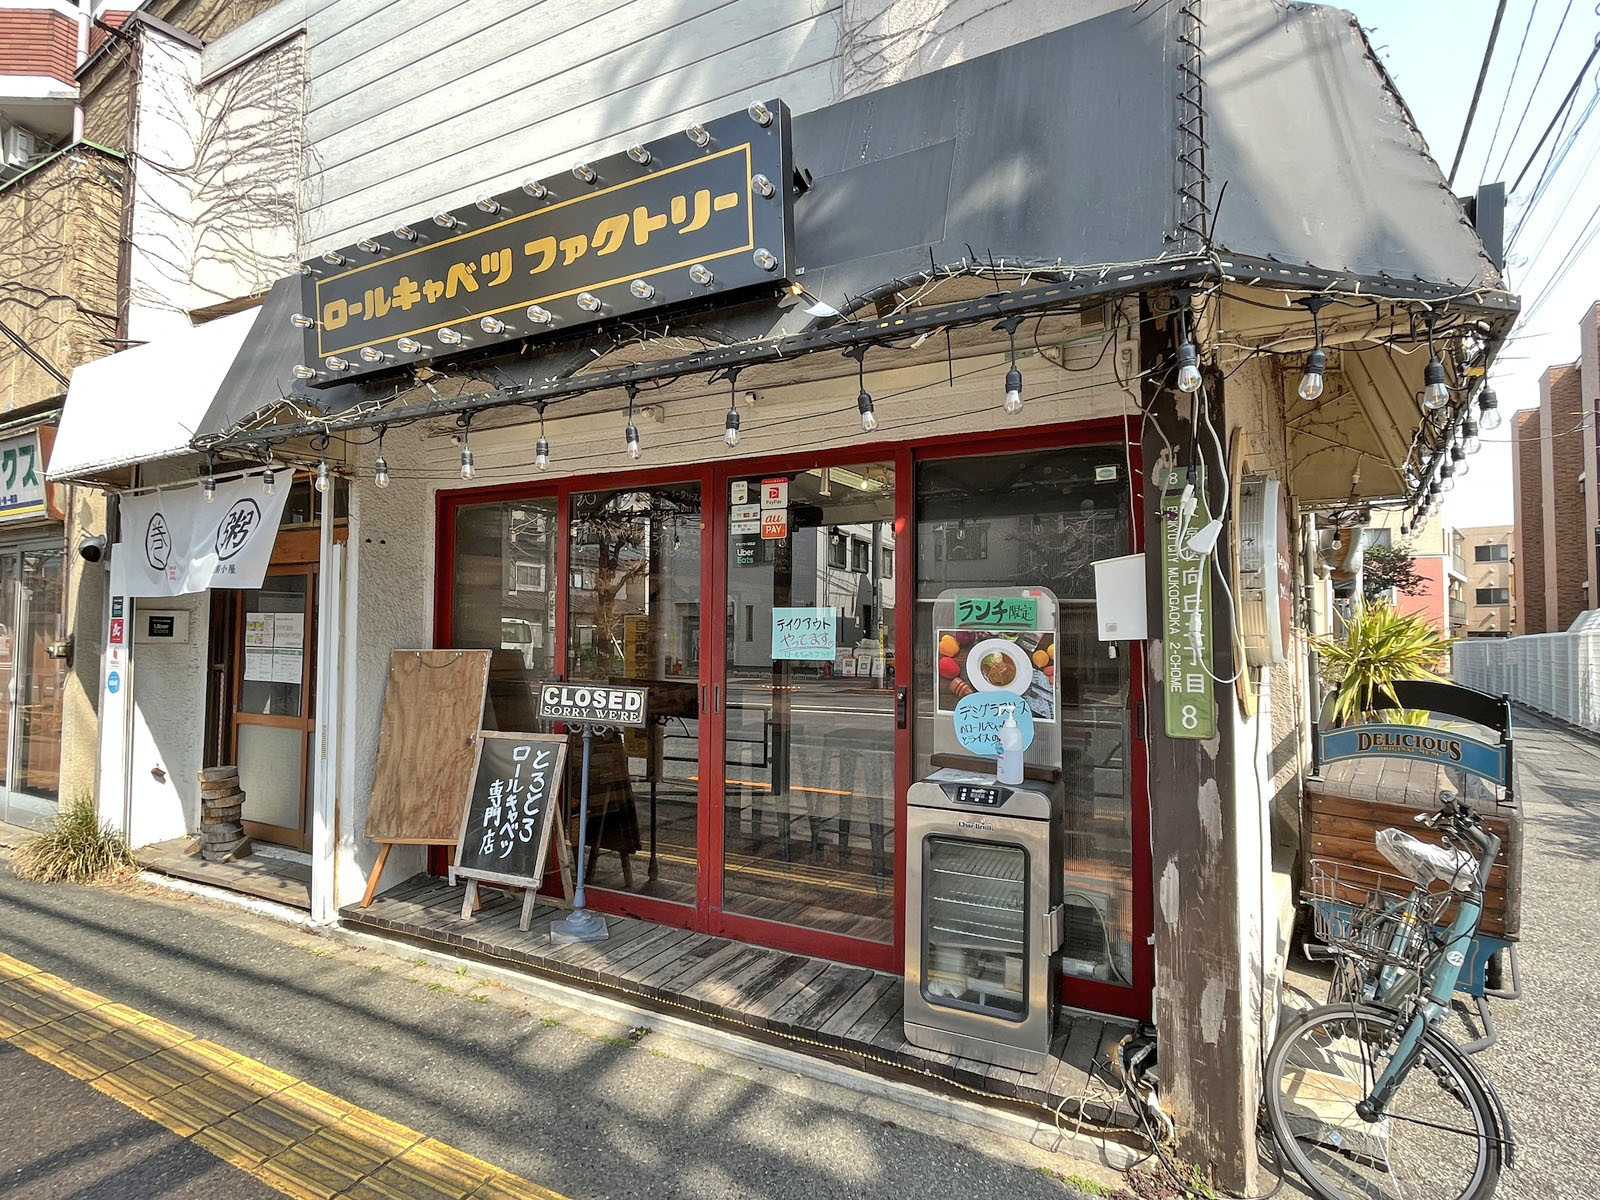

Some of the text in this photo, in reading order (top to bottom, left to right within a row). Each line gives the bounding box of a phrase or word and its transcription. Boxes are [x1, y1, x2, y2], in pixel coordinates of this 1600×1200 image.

[323, 189, 739, 332] ロールキャベツ ファクトリー
[765, 514, 783, 523] au
[766, 525, 782, 534] PAY
[736, 548, 754, 556] Uber
[736, 556, 754, 564] Eats
[1168, 567, 1181, 635] MUKOGAOKA
[776, 617, 831, 632] テイクアウト
[1169, 642, 1182, 693] 2-CHOME
[543, 686, 641, 711] CLOSED
[543, 704, 639, 722] SORRY WE'RE
[1357, 732, 1462, 761] DELICIOUS
[498, 745, 531, 859] ロールキャベツ
[517, 748, 551, 843] とろとろ
[478, 778, 503, 856] 専門店
